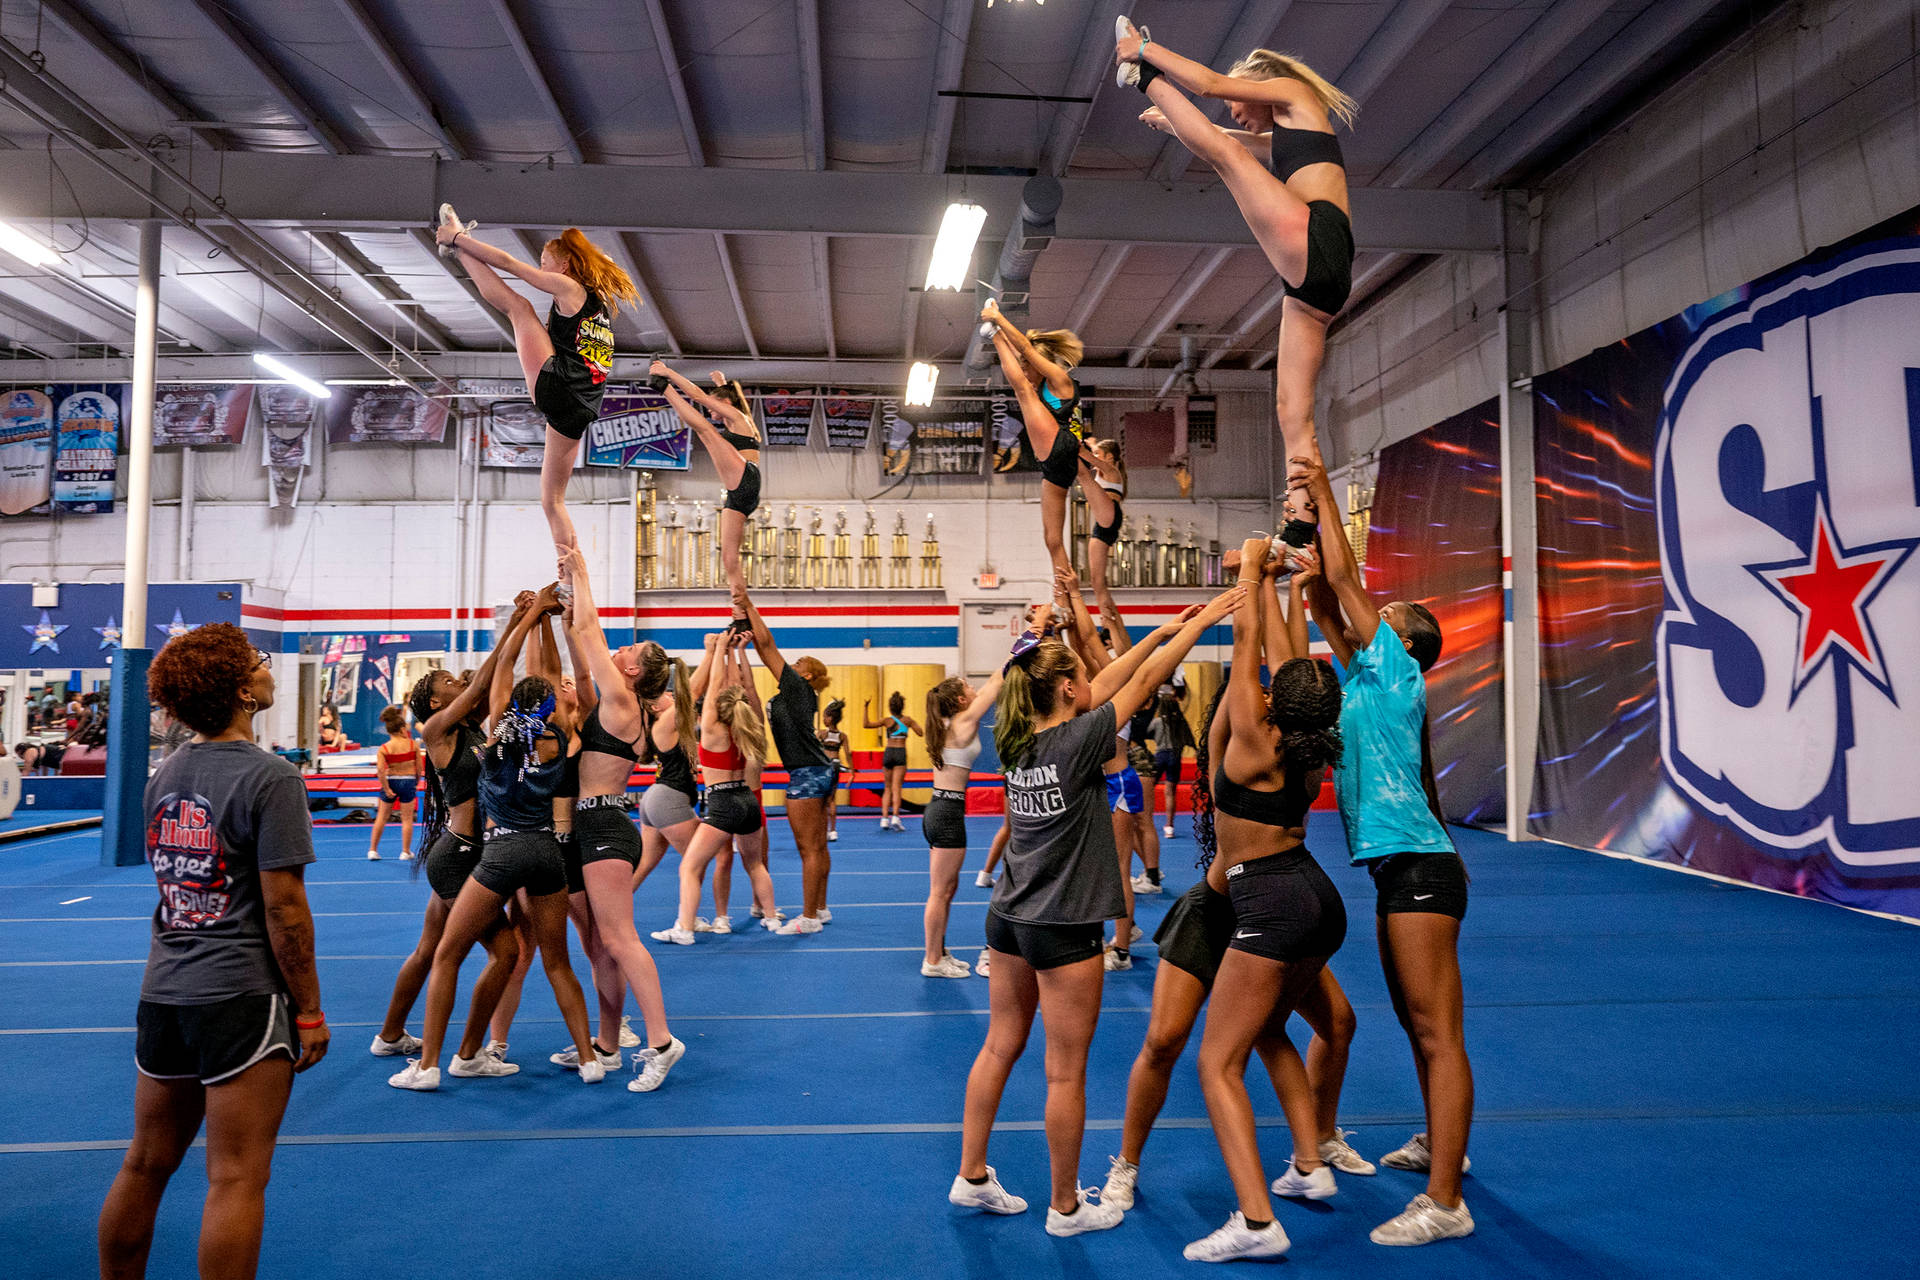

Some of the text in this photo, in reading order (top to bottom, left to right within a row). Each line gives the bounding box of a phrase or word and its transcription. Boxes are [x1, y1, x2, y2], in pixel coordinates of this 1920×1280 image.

[592, 408, 688, 447] CHEERSPOR
[178, 800, 207, 828] It's
[158, 818, 212, 849] About
[174, 853, 213, 878] get
